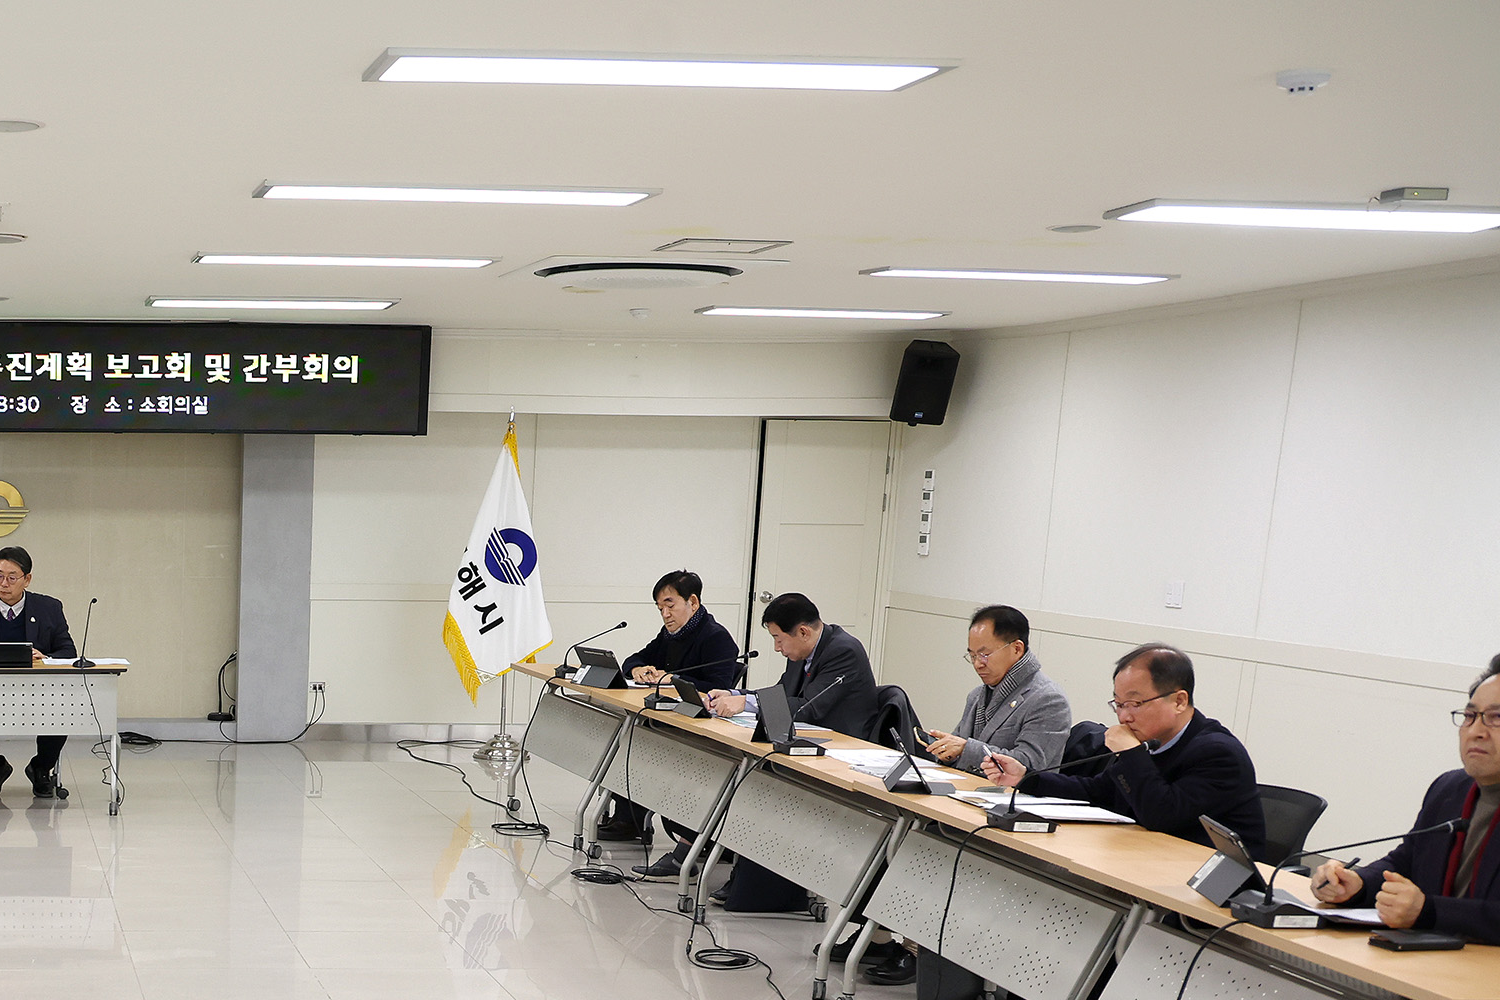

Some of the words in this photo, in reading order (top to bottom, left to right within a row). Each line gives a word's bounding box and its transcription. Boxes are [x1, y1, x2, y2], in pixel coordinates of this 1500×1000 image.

[103, 352, 192, 382] 보고회
[204, 353, 231, 384] 및
[242, 353, 359, 384] 간부회의
[70, 395, 90, 414] 장
[138, 395, 209, 415] 소회의실
[457, 550, 504, 636] 해시
